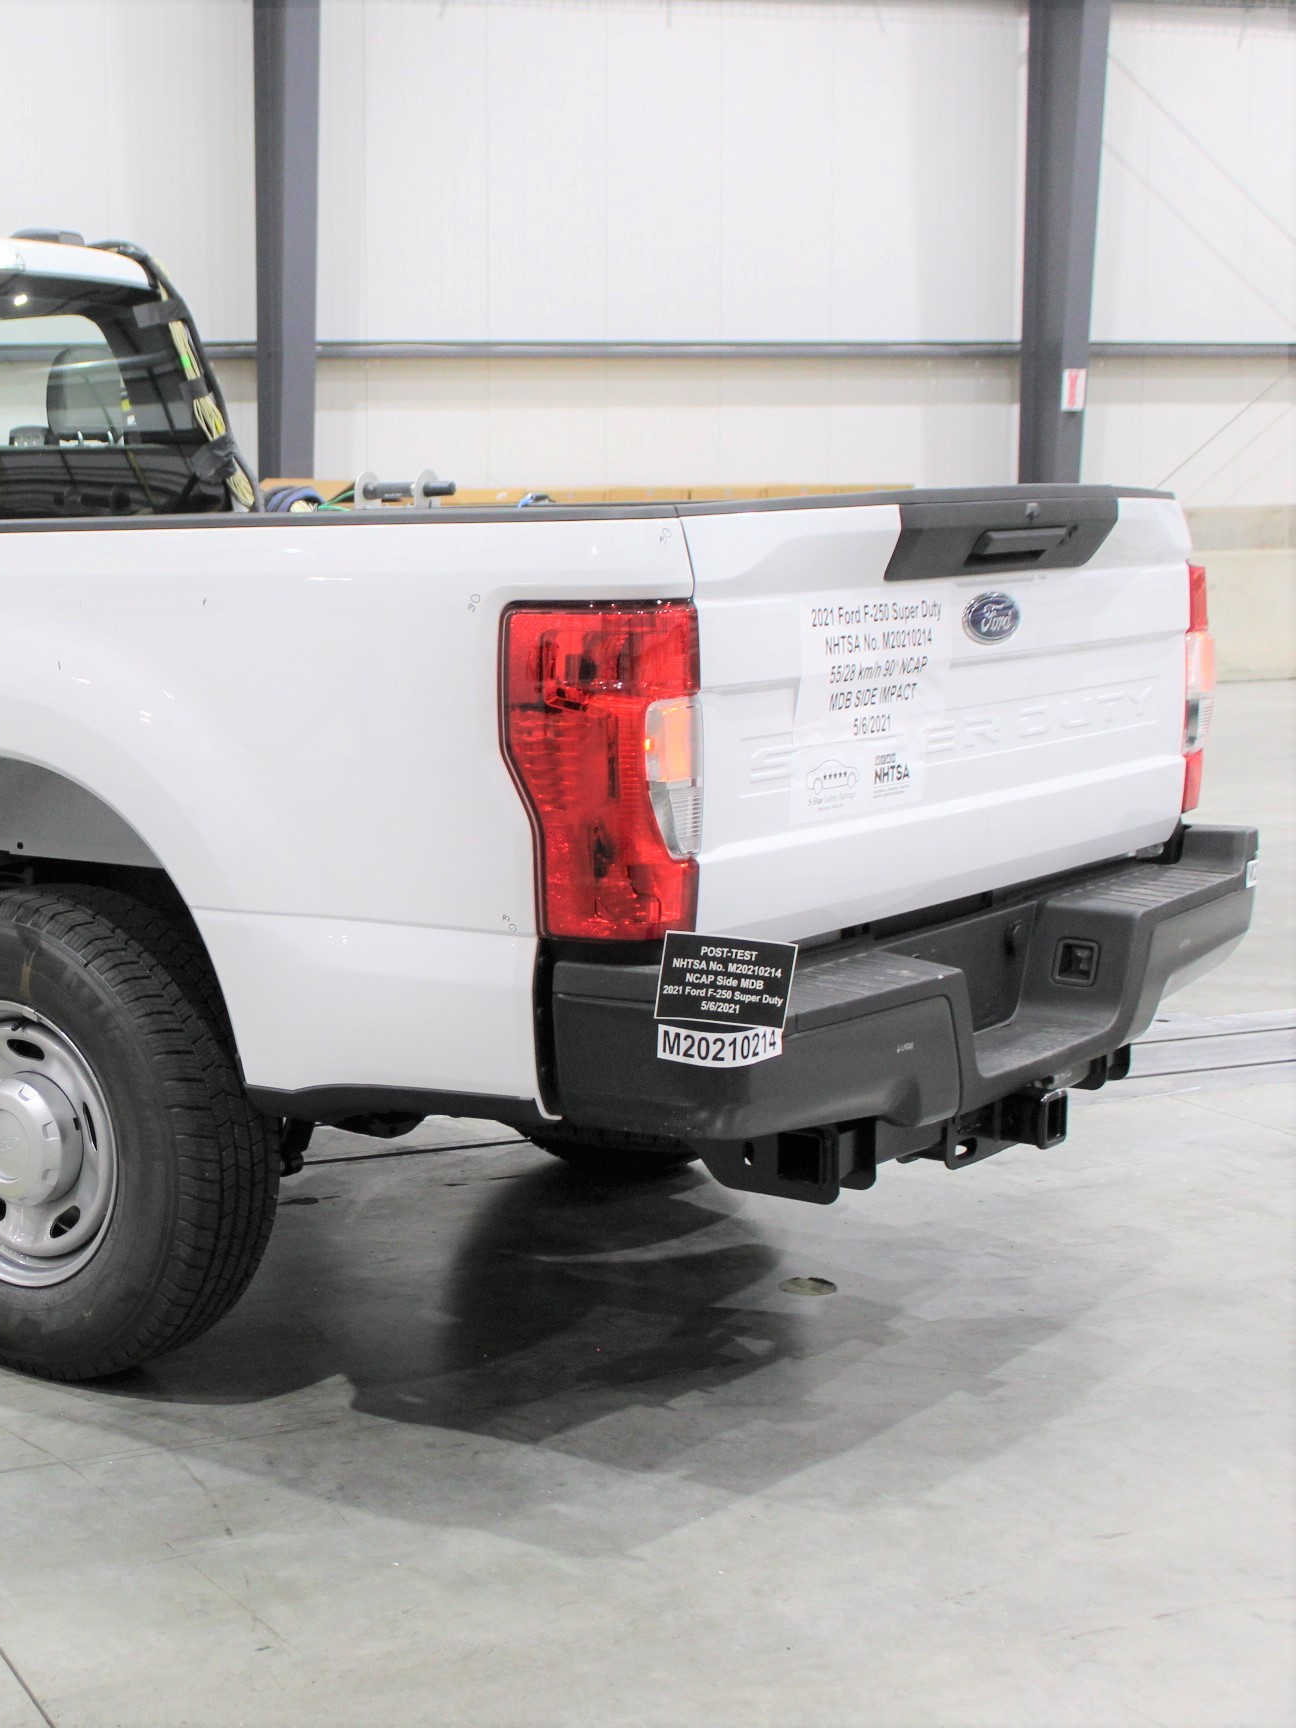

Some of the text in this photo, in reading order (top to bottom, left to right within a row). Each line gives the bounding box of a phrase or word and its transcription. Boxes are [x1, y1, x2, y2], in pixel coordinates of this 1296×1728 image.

[811, 600, 943, 628] 2021 Ford F-250 Super Duty
[980, 604, 1013, 632] Ford
[825, 629, 933, 656] NHTSA No. M20210214
[829, 665, 857, 684] 55/28
[857, 662, 882, 681] km/h
[899, 655, 929, 675] NCAP
[828, 683, 918, 712] MDB SIDE IMPACT
[853, 714, 892, 736] 5/6/2021
[874, 763, 911, 785] NHTSA
[700, 946, 758, 961] POST-TEST
[672, 958, 782, 979] NHTSA No. M20210214
[685, 973, 764, 990] NCAP Side MDB
[663, 985, 784, 1007] 2021 Ford F-250 Super Duty
[700, 1001, 740, 1014] 5/6/2021
[662, 1029, 777, 1062] M20210214
